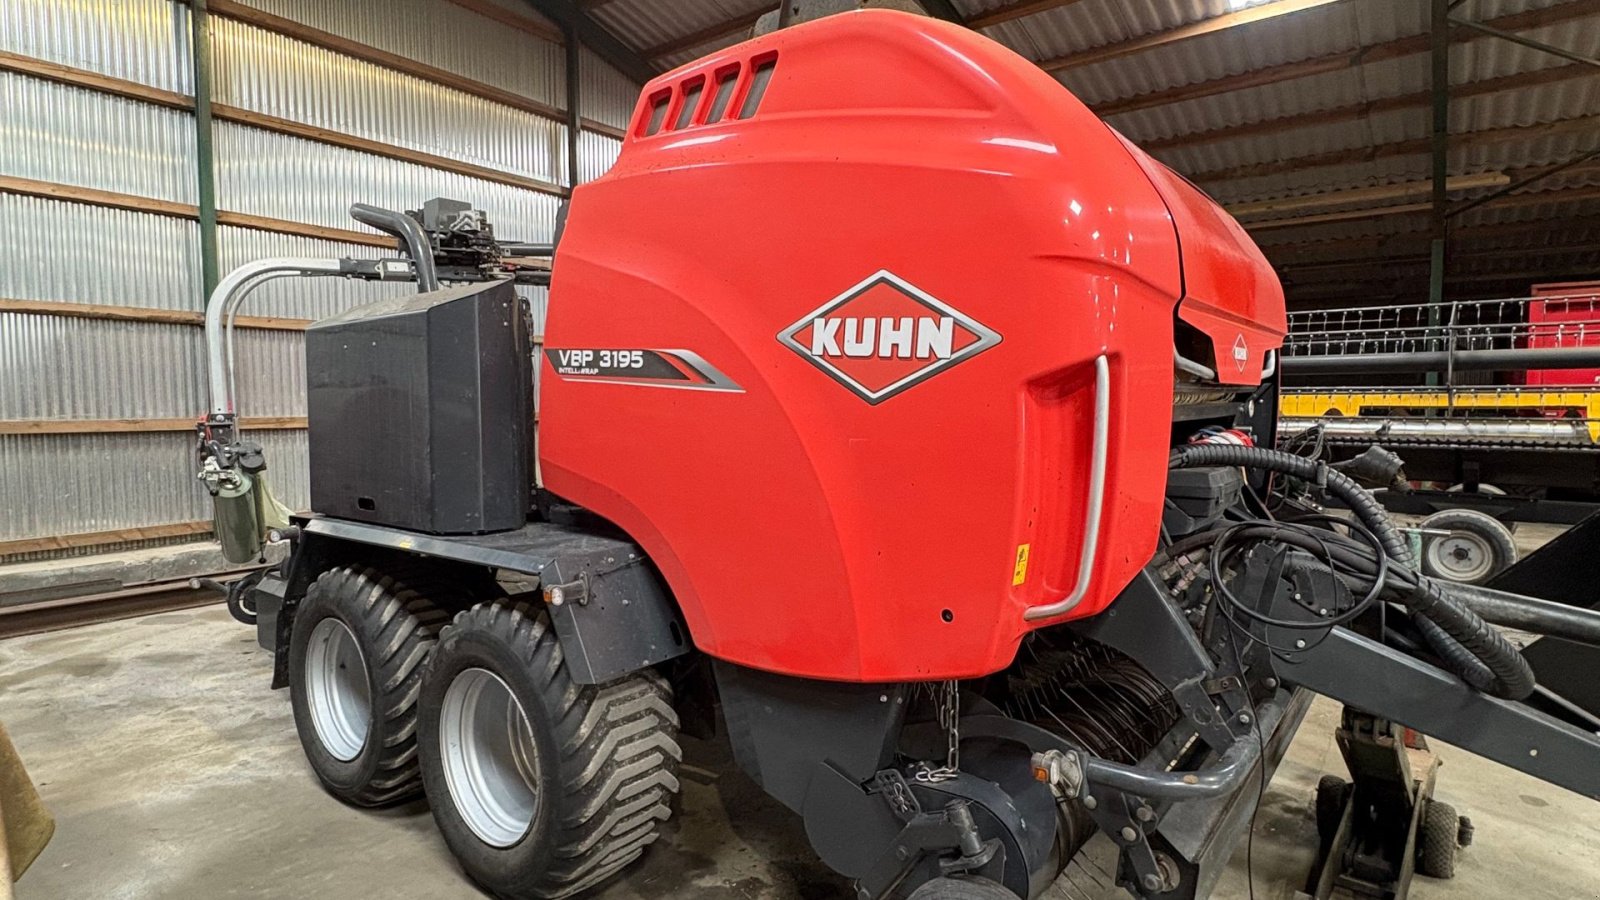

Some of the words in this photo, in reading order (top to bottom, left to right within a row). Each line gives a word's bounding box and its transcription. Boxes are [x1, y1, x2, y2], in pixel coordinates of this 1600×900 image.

[810, 316, 954, 360] KUHN
[558, 349, 594, 367] VBP
[599, 350, 644, 369] 3195
